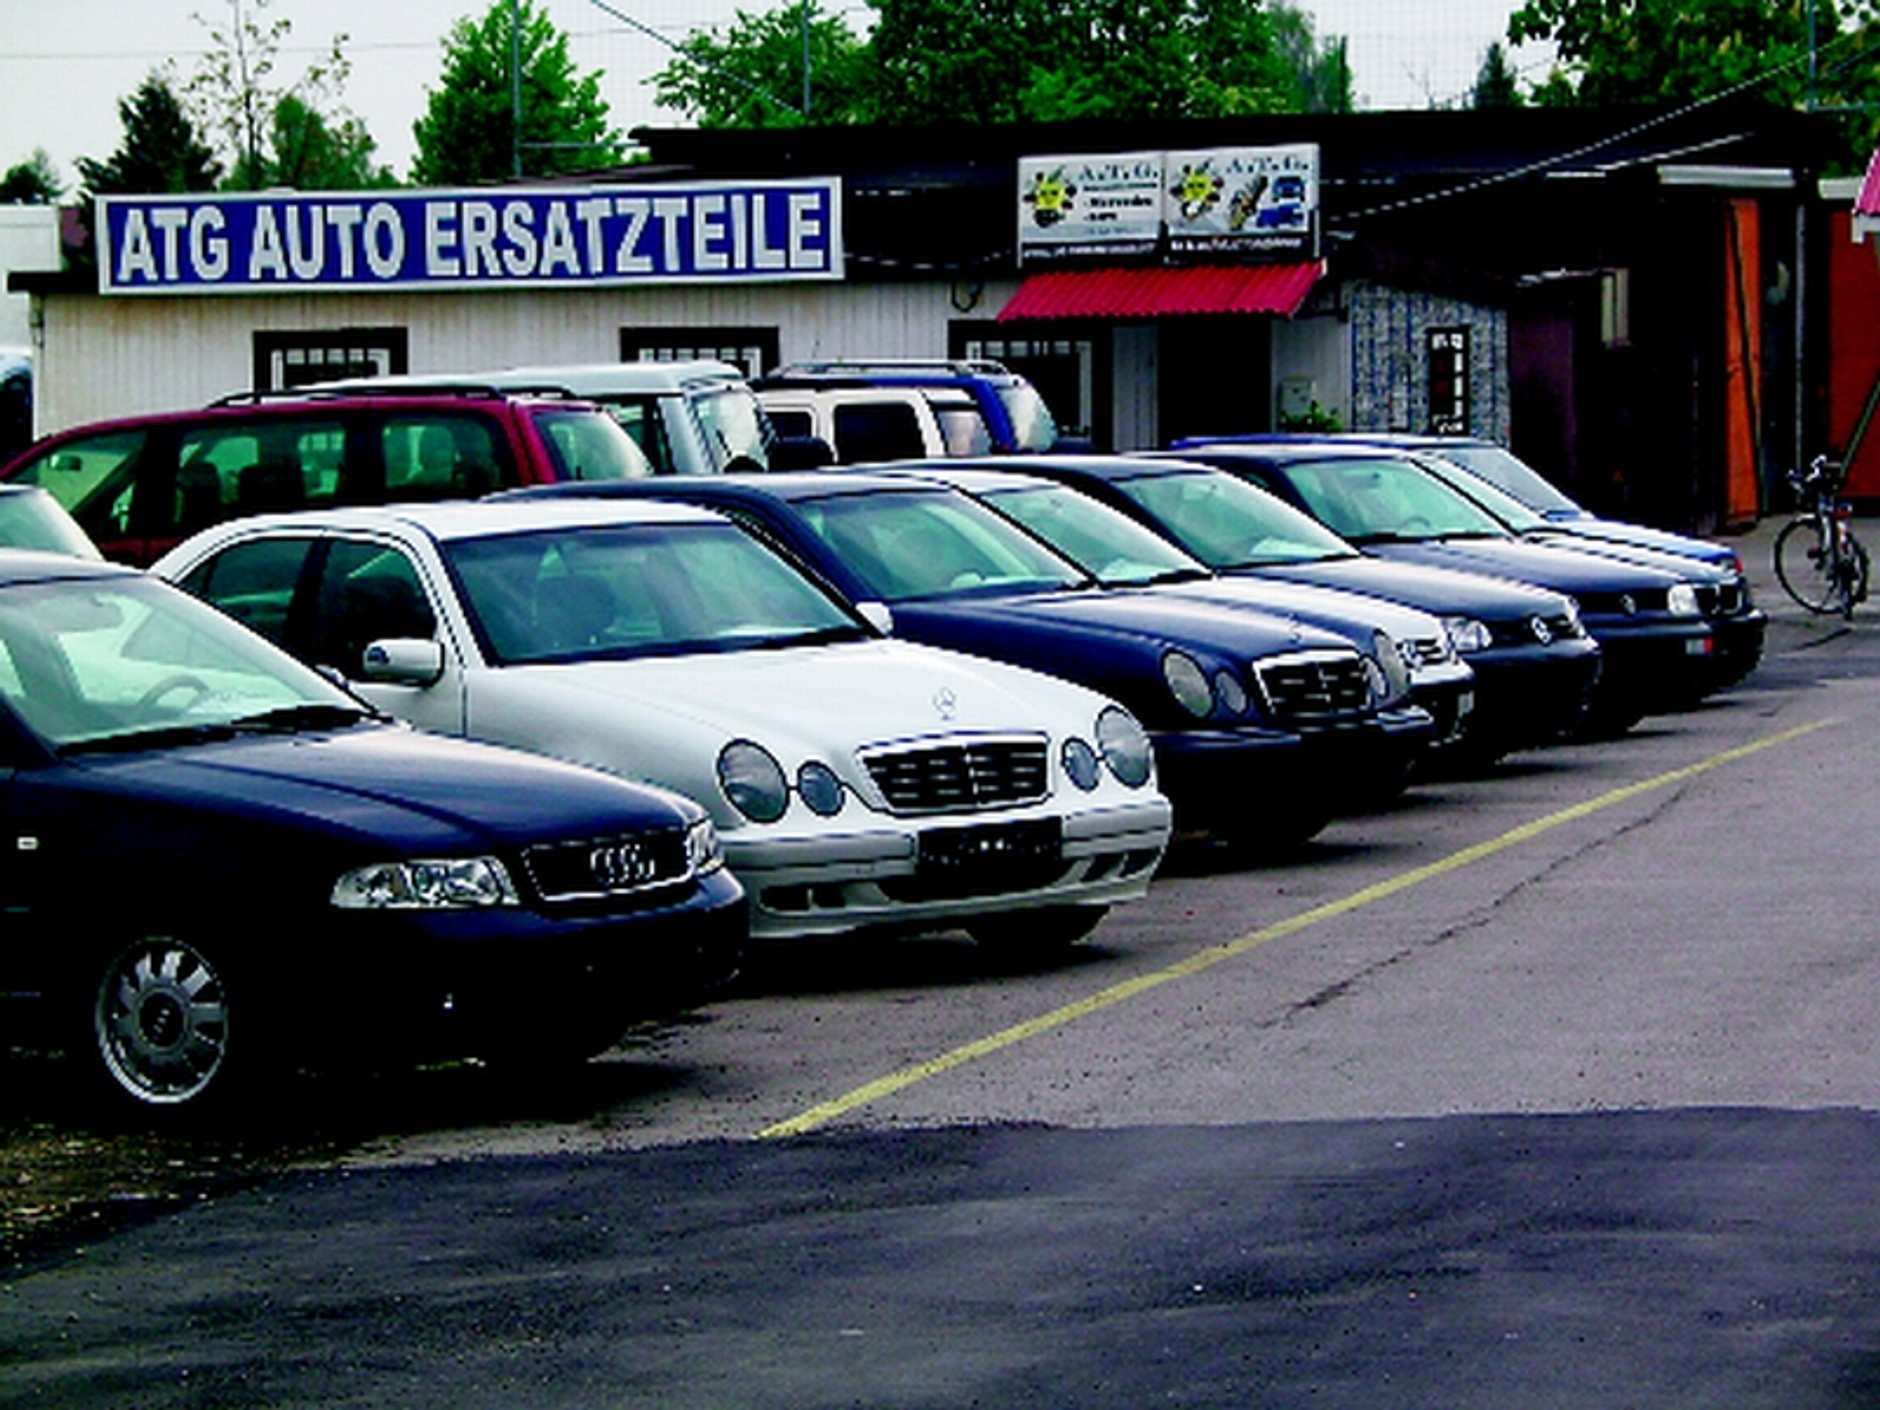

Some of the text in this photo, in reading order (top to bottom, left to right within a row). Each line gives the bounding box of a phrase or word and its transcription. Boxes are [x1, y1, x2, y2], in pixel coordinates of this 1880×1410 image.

[117, 192, 825, 281] ATG AUTO ERSATZTEILE
